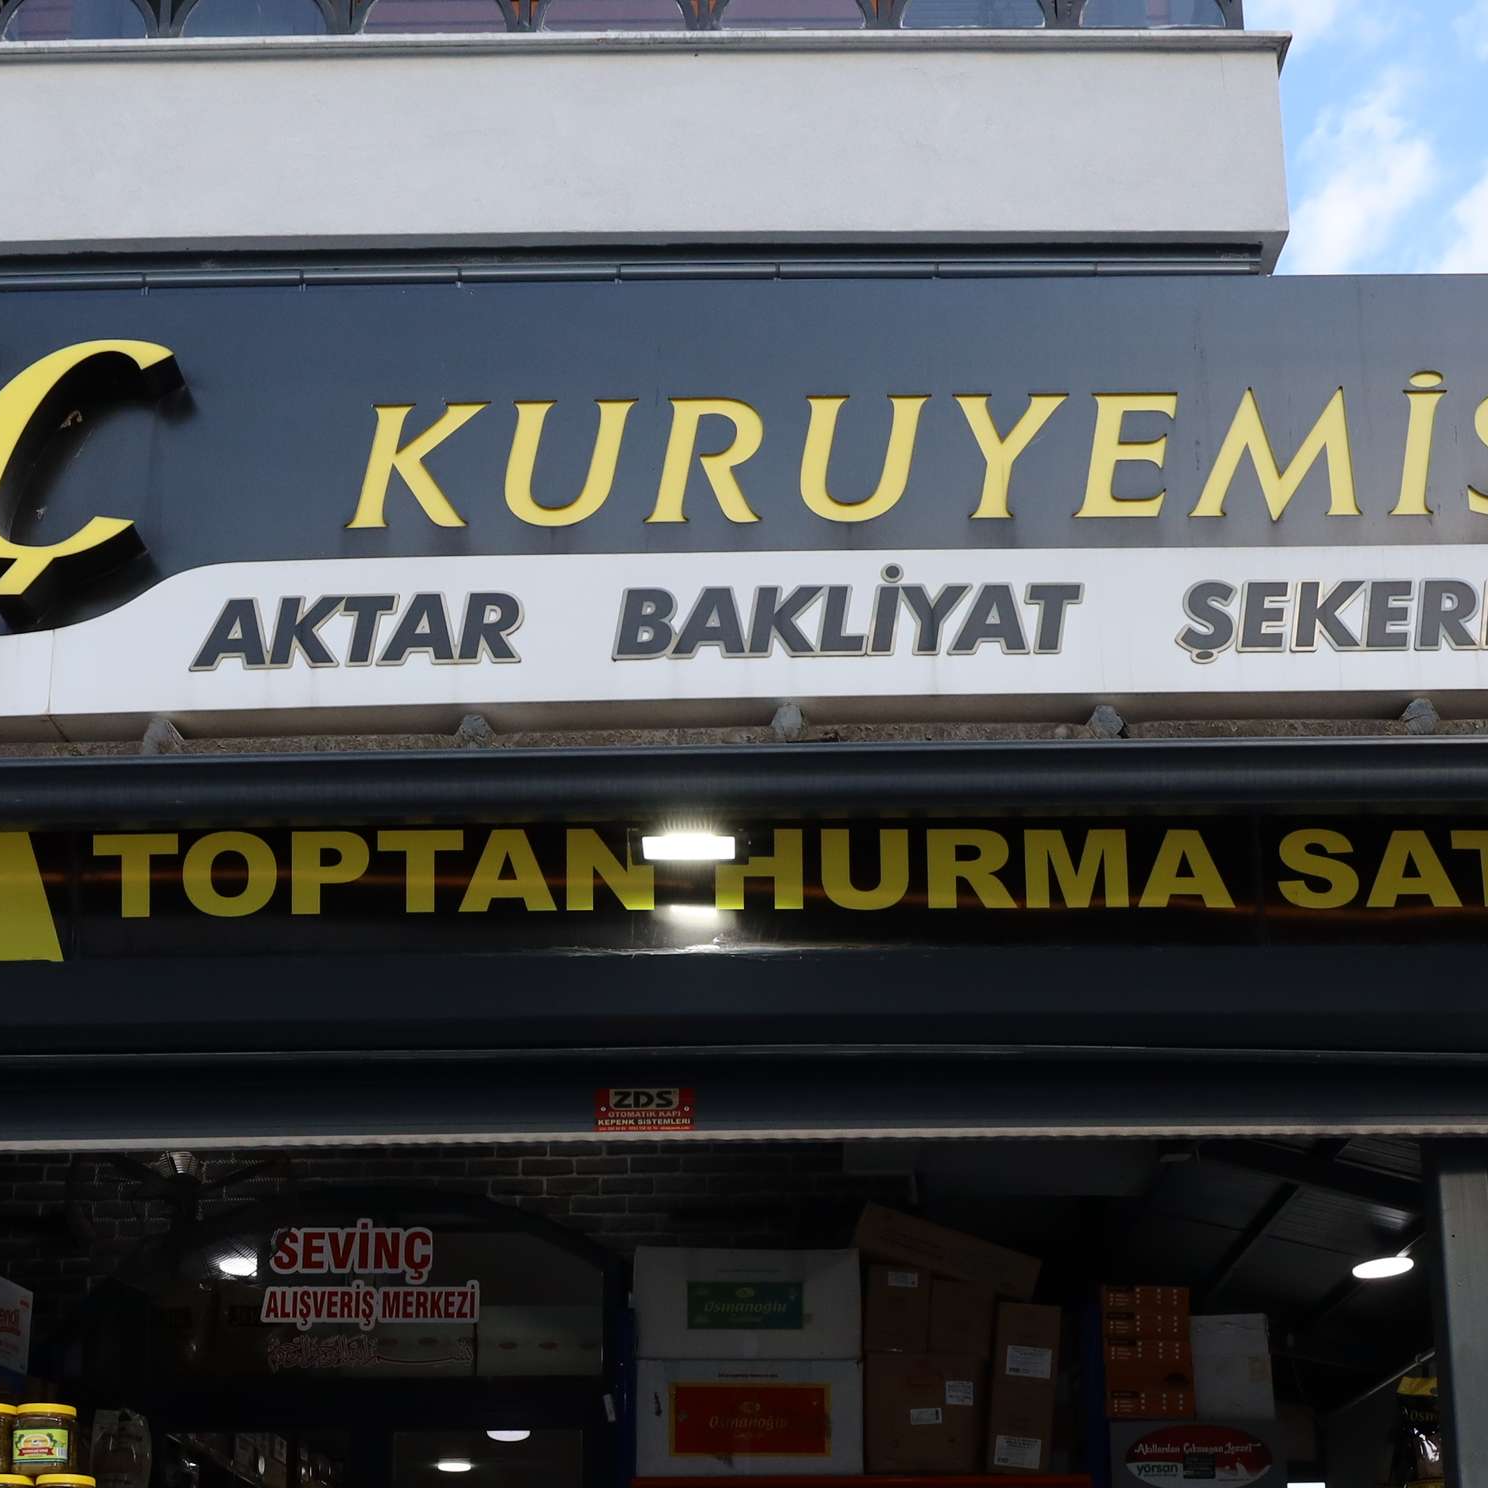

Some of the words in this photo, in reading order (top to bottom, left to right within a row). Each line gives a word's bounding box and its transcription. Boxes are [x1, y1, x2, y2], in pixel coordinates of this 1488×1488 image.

[189, 592, 524, 672] AKTAR
[612, 562, 1085, 662] BAKLİYAT
[92, 828, 656, 919] TOPTAN
[715, 828, 1237, 911] HURMA
[614, 1090, 674, 1108] ZDS
[273, 1221, 432, 1281] SEVİNÇ
[264, 1283, 374, 1327] ALIŞVERİŞ
[381, 1283, 476, 1319] MERKEZİ
[1136, 1462, 1178, 1476] yörsan
